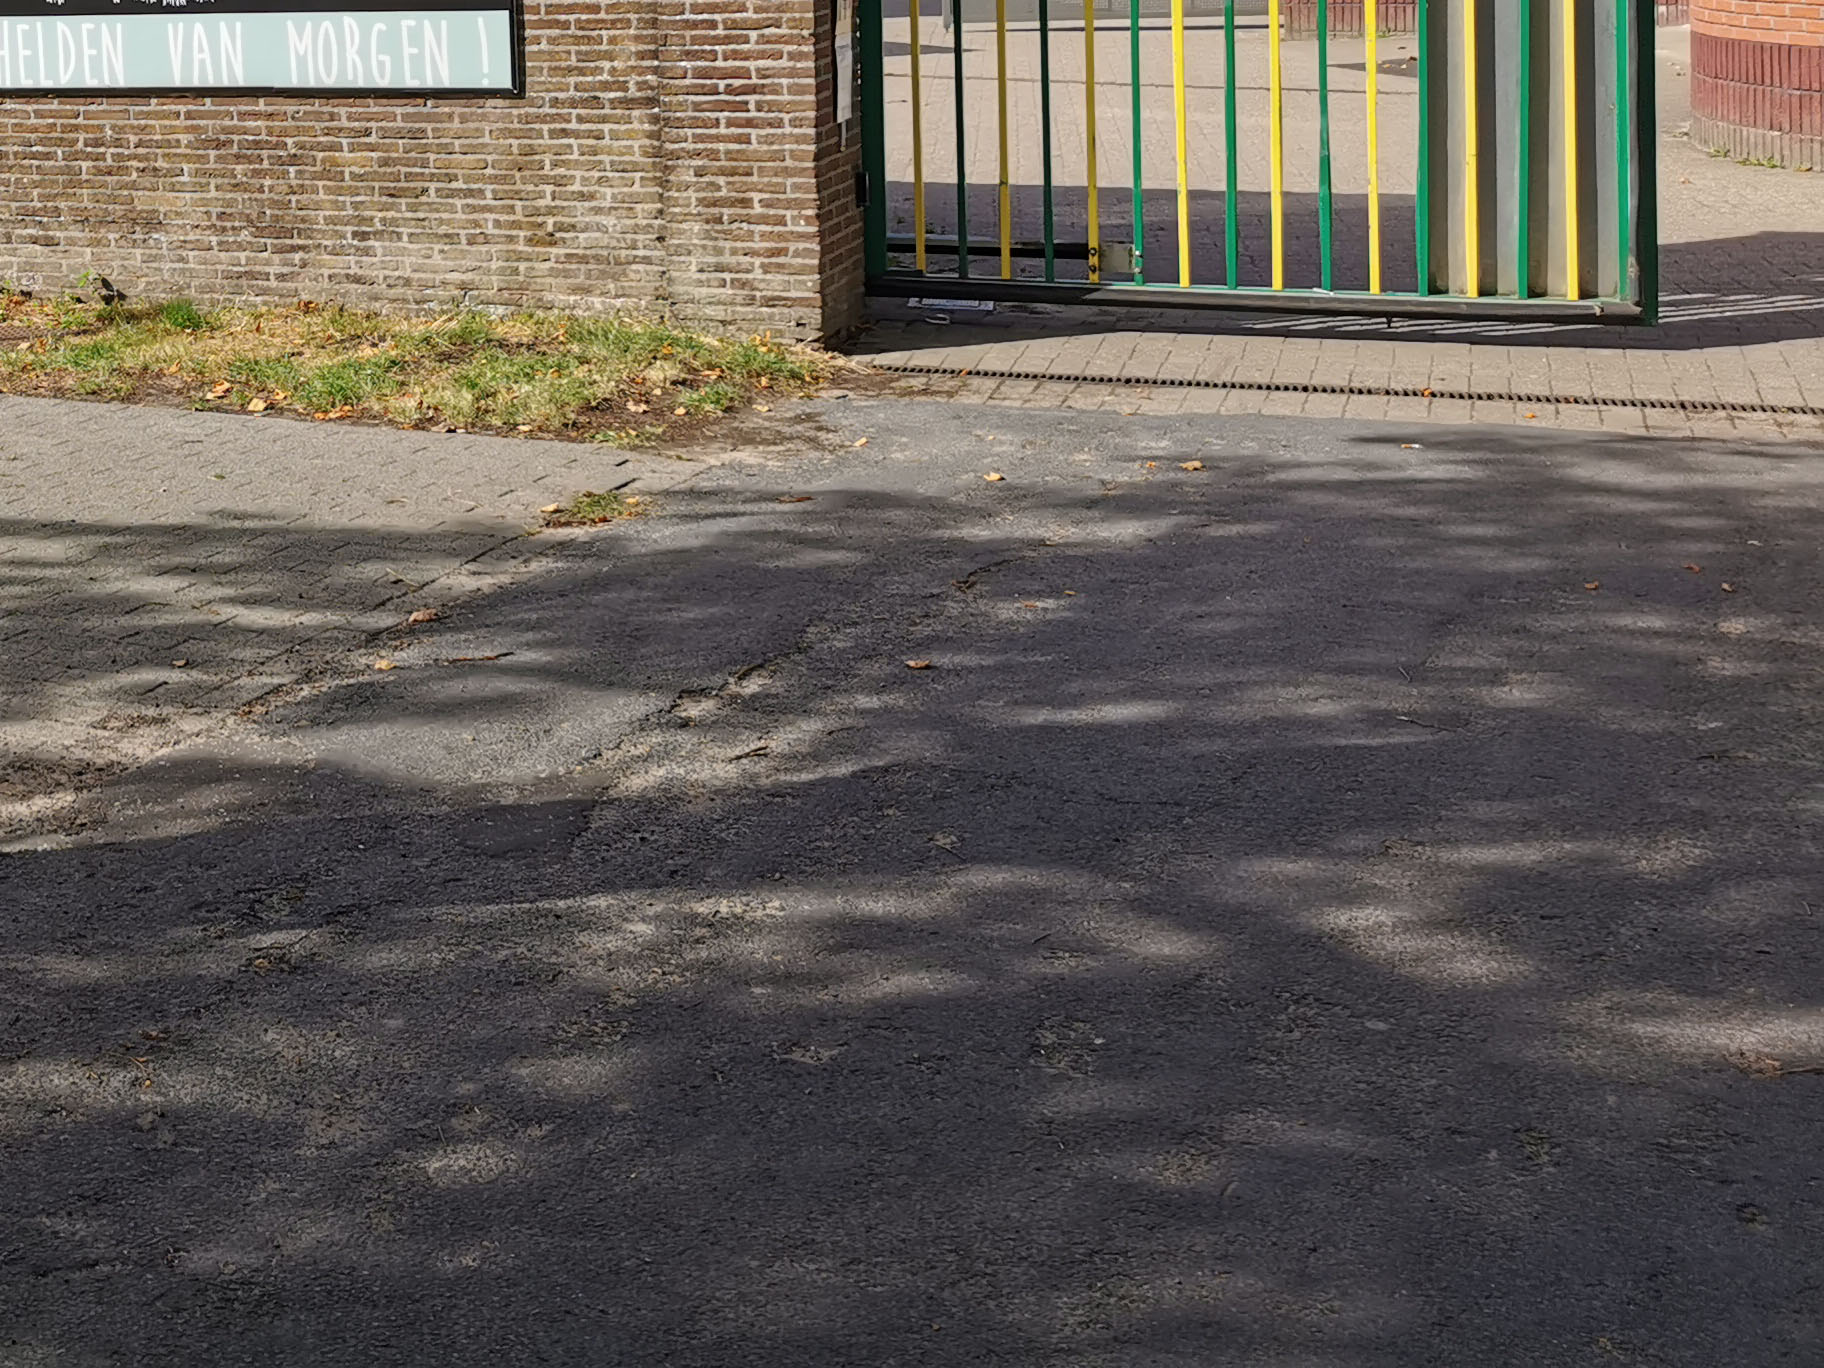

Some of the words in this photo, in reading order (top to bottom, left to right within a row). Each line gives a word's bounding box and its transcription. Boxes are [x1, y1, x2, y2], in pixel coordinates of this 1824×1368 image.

[167, 20, 245, 87] VAN
[286, 15, 451, 87] MORGEN
[477, 16, 491, 86] !
